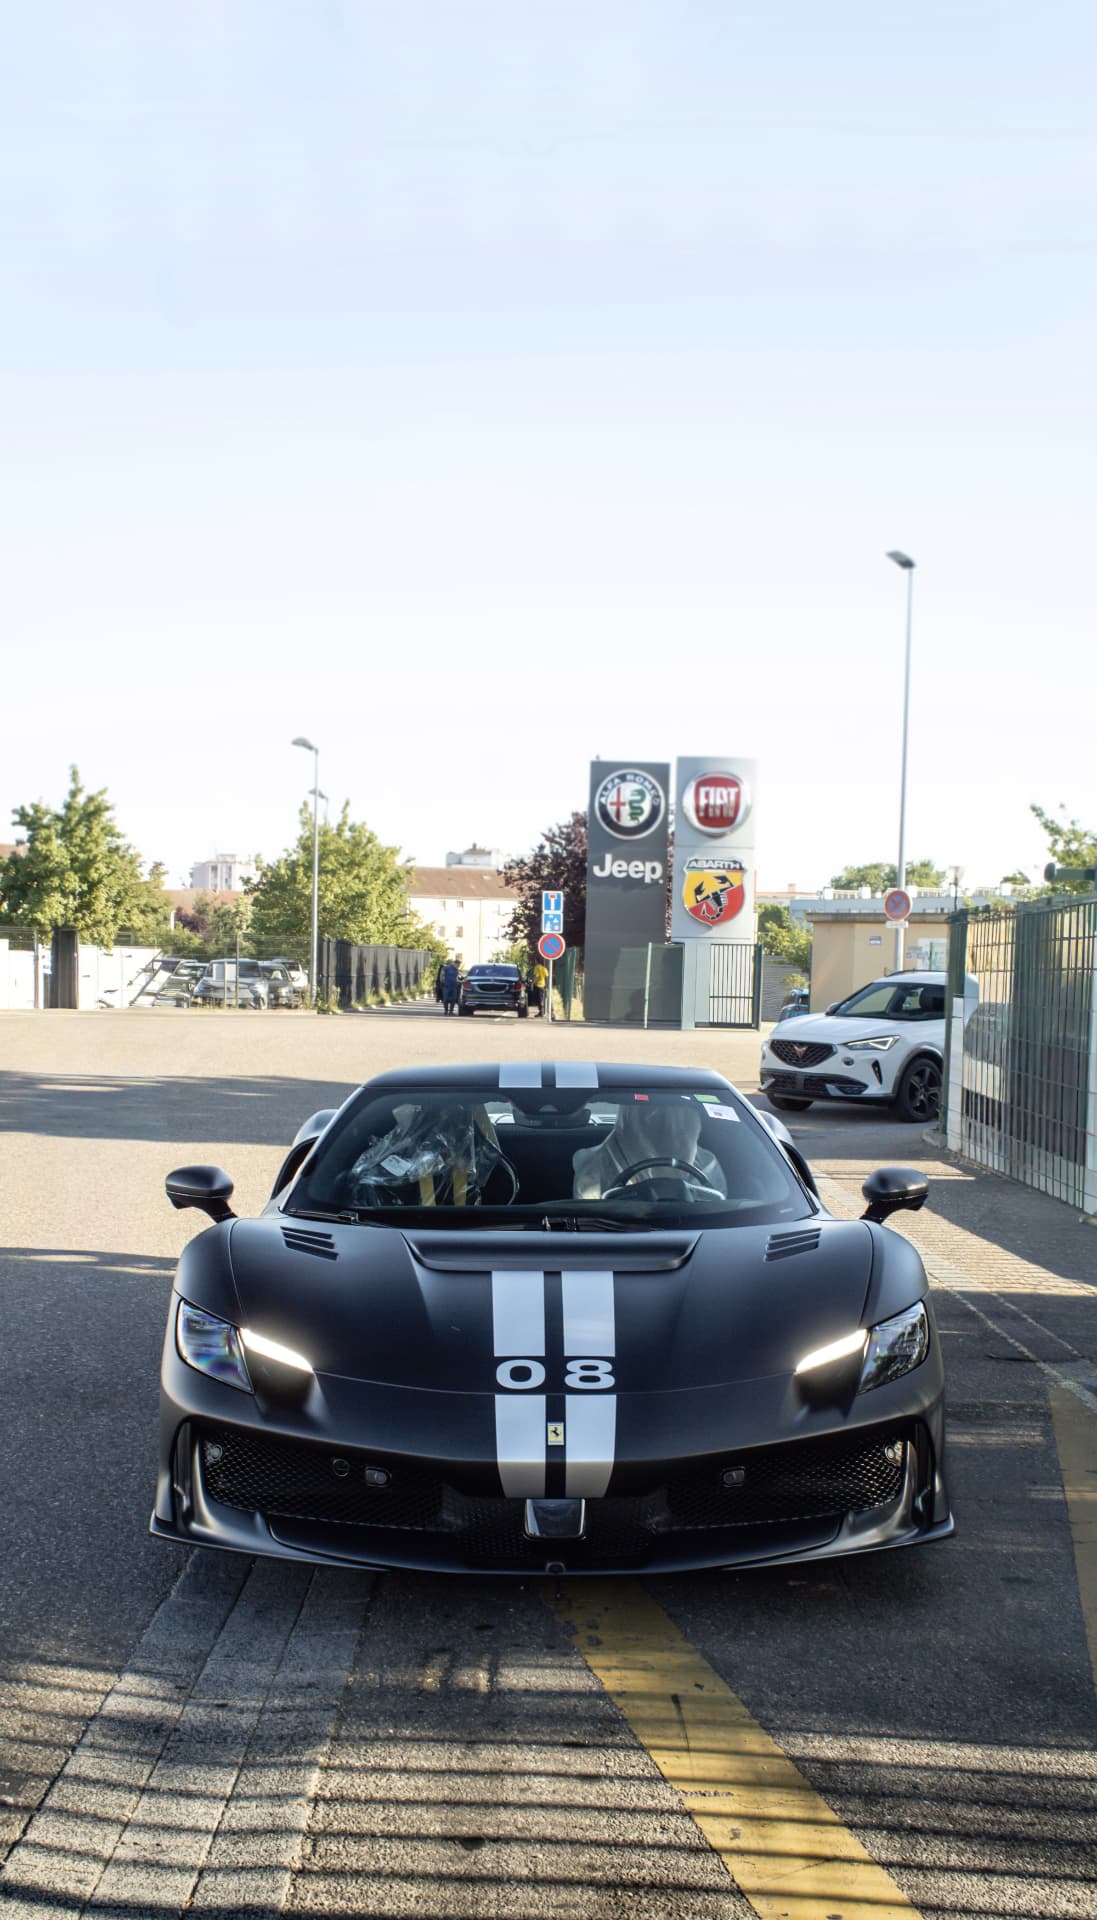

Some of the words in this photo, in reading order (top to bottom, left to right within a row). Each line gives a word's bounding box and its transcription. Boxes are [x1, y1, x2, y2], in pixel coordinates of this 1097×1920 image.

[599, 776, 622, 805] ALFA
[625, 773, 661, 806] ROMEO
[698, 786, 739, 818] FIAT
[592, 853, 662, 884] Jeep
[688, 860, 741, 869] ABARTH
